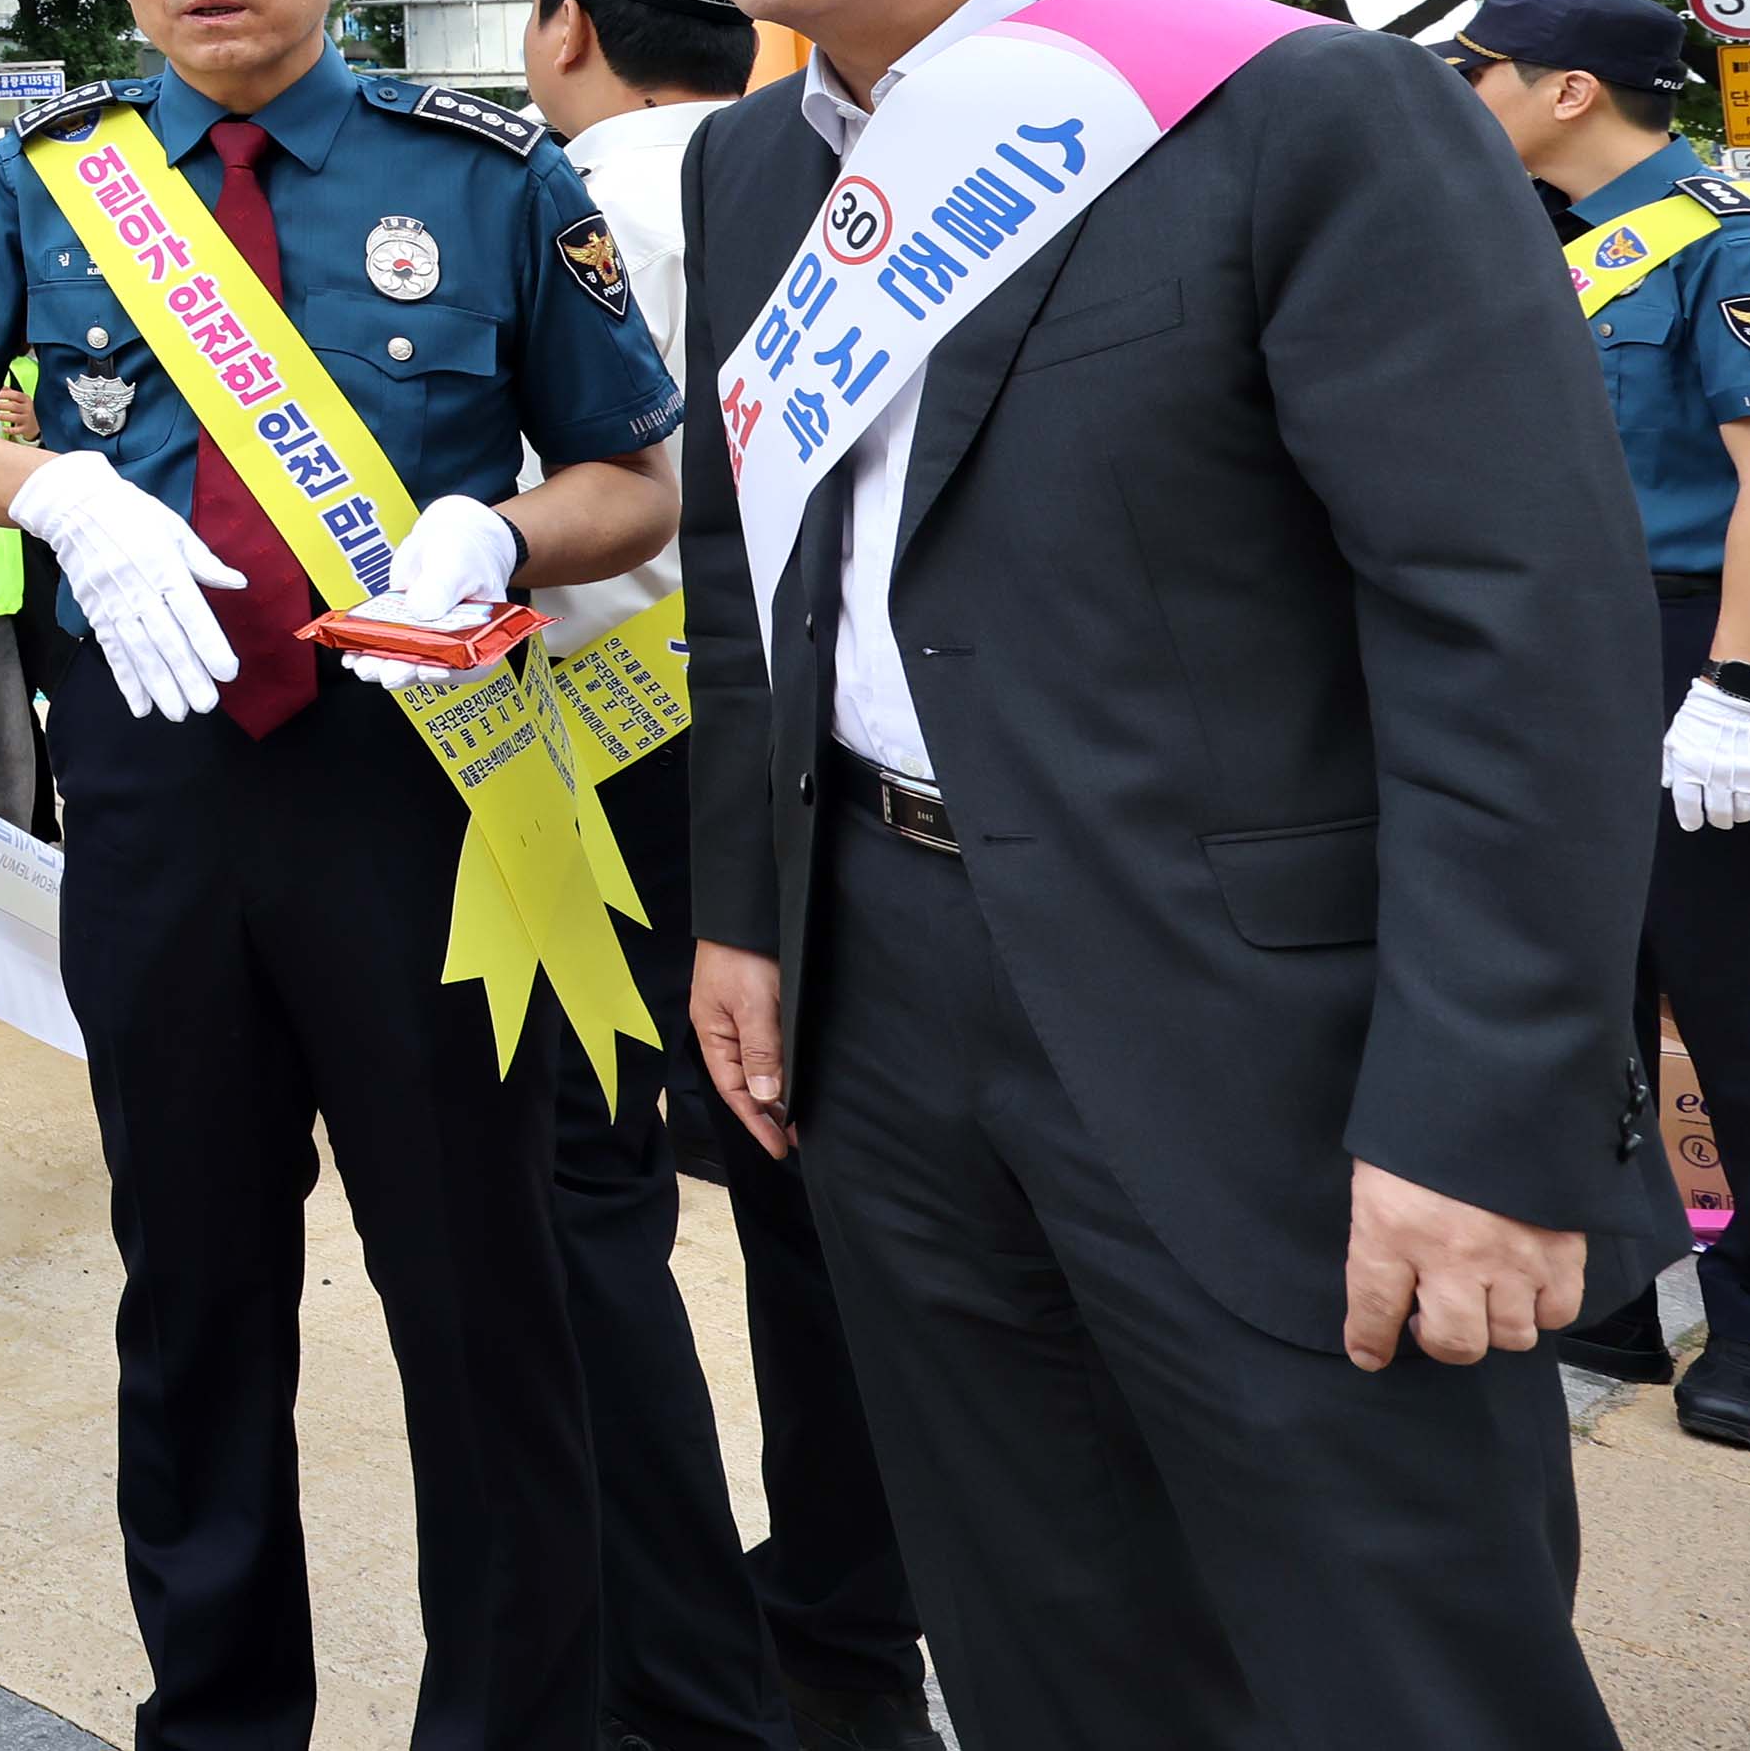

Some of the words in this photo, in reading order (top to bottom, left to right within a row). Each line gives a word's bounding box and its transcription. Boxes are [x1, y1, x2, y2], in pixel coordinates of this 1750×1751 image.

[831, 191, 878, 241] 30
[877, 116, 1087, 320] 스쿨존
[76, 145, 191, 283] 어린이가
[165, 280, 283, 409] 안전한
[257, 400, 347, 503] 인천
[754, 250, 839, 381] 이하
[782, 329, 890, 463] 시속
